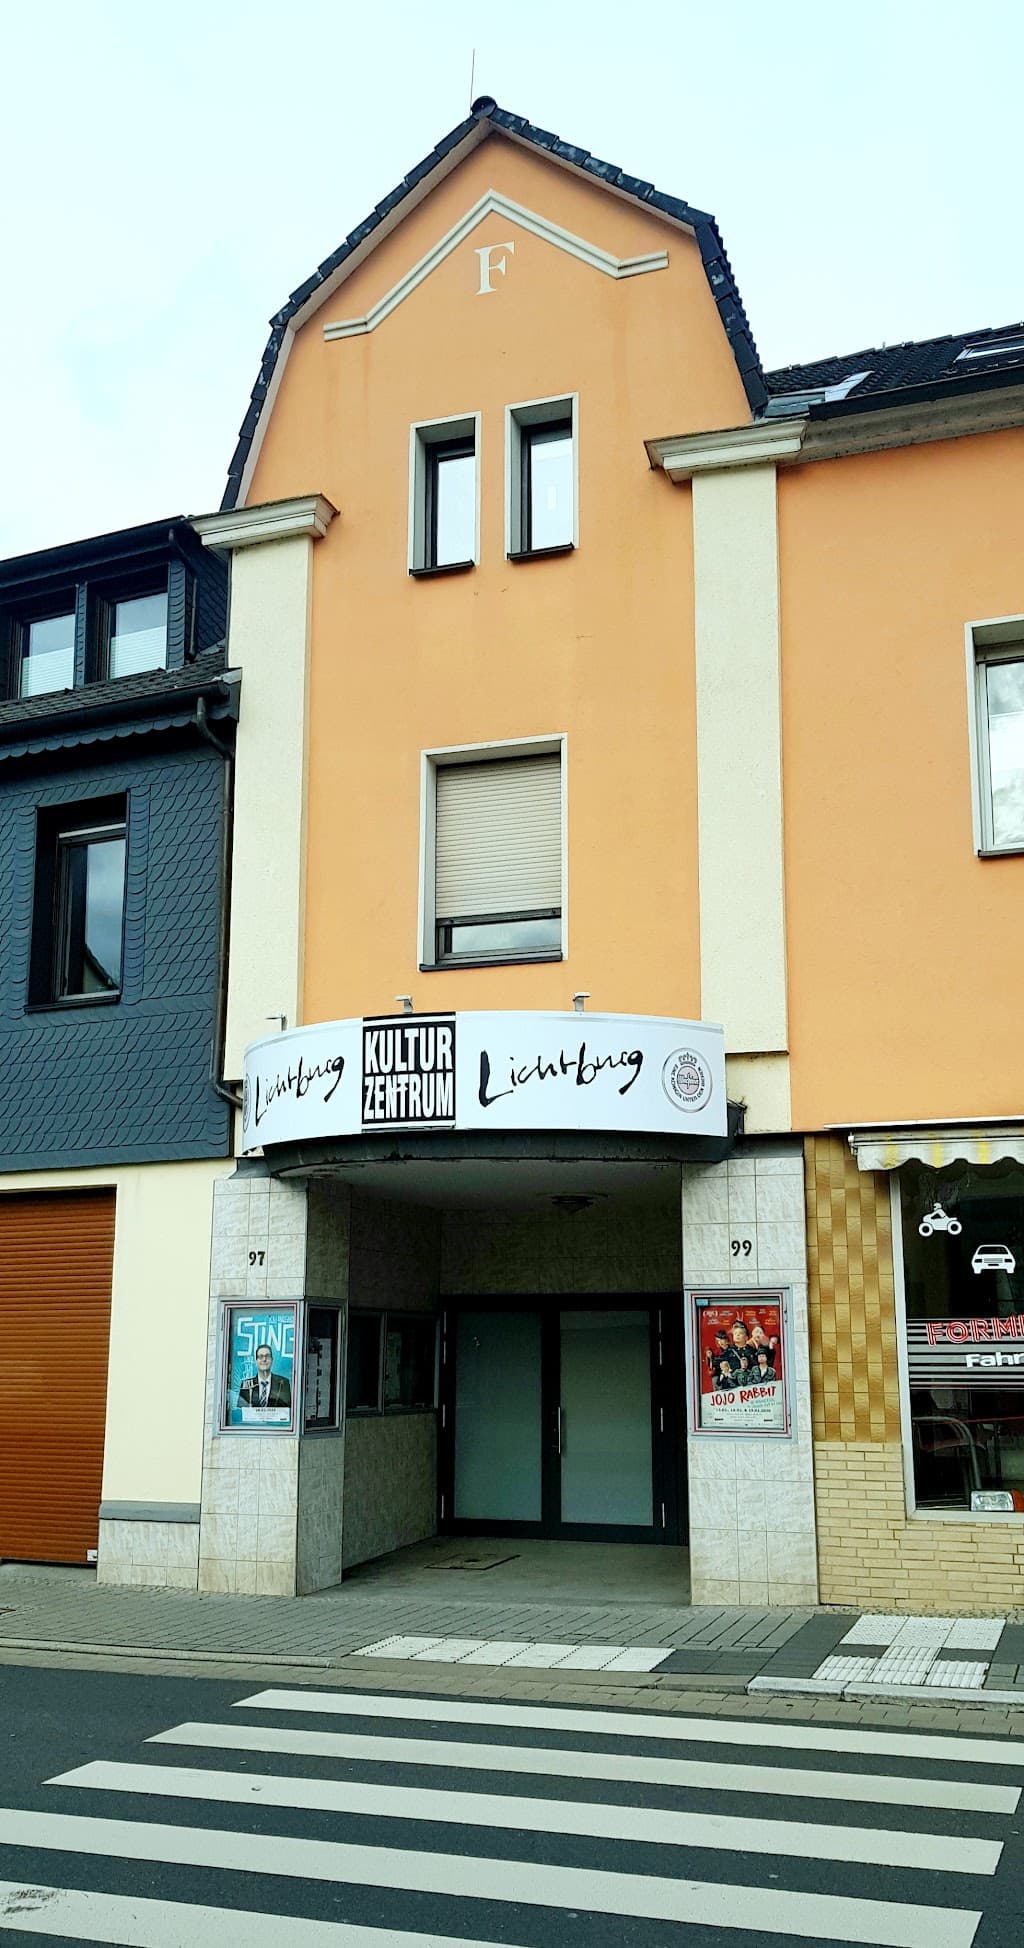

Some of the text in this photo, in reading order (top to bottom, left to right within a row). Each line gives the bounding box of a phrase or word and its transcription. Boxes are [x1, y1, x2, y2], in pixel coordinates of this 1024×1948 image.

[473, 241, 515, 296] F
[365, 1026, 453, 1074] KULTUR
[255, 1056, 345, 1127] Lichtburg
[363, 1072, 454, 1120] ZENTRUM
[479, 1041, 644, 1108] Lichtburg
[249, 1251, 266, 1266] 97
[731, 1240, 752, 1256] 99
[710, 1386, 776, 1407] JOJO RABBIT
